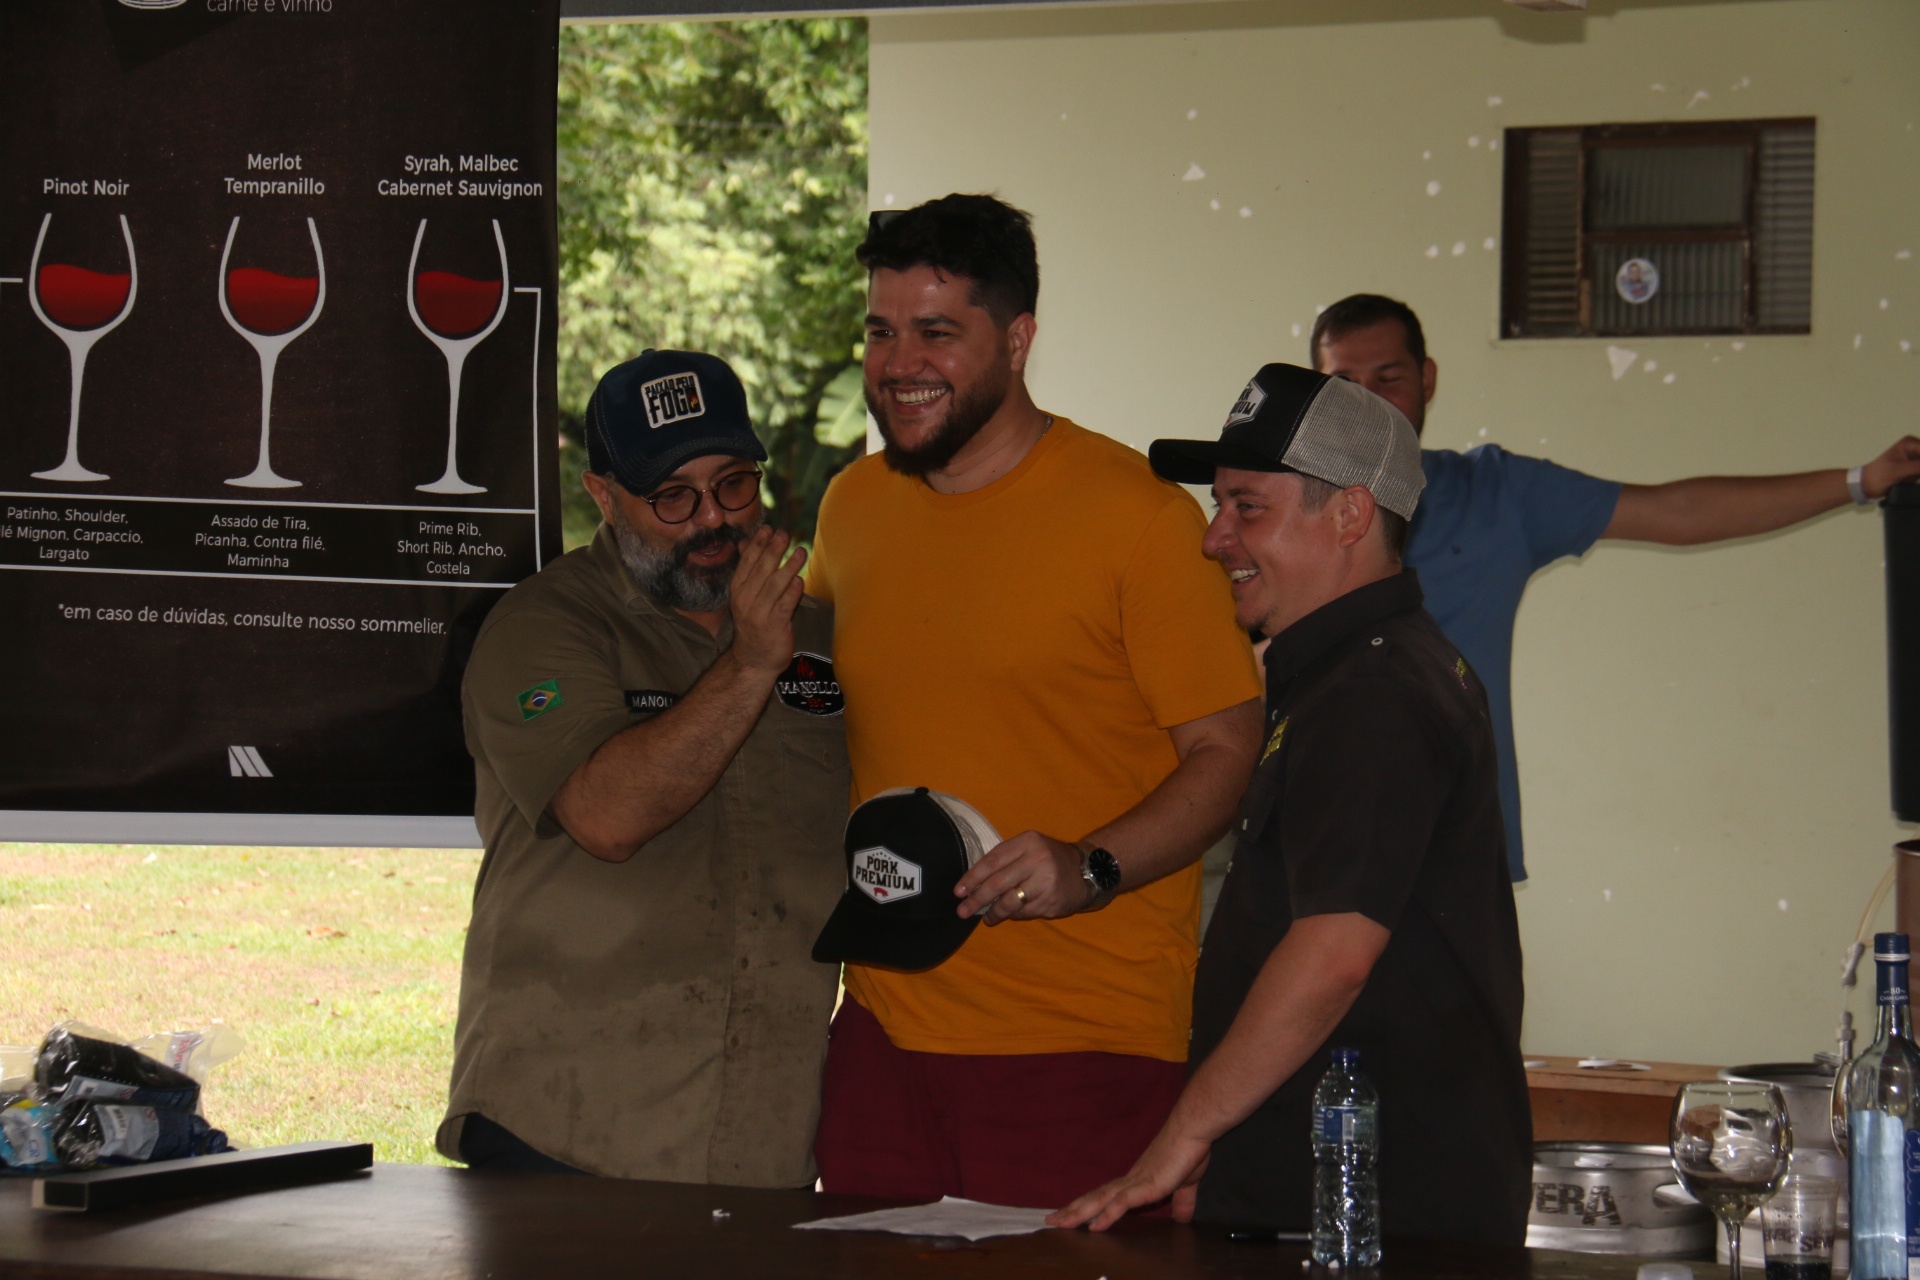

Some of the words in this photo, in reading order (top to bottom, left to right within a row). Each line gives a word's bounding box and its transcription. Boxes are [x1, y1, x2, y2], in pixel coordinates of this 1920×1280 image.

[207, 0, 258, 12] carne
[265, 0, 275, 11] e
[248, 153, 302, 170] Merlot
[405, 154, 453, 175] Syrah,
[460, 155, 518, 171] Malbec
[44, 178, 88, 194] Pinot
[94, 179, 129, 195] Noir
[224, 178, 324, 197] Tempranillo
[378, 179, 453, 195] Cabernet
[458, 179, 542, 199] Sauvignon
[8, 507, 60, 521] Patinho,
[65, 509, 128, 523] Shoulder,
[211, 515, 258, 527] Assado
[262, 516, 279, 528] de
[284, 517, 309, 530] Tira,
[0, 525, 13, 538] lé
[17, 527, 69, 541] Mignon,
[74, 529, 143, 543] Carpaccio,
[420, 522, 453, 534] Prime
[458, 523, 481, 536] Rib,
[196, 533, 249, 547] Picanha,
[254, 535, 297, 548] Contra
[303, 536, 325, 549] filé,
[398, 540, 429, 553] Short
[434, 542, 455, 555] Rib,
[459, 543, 506, 557] Ancho,
[39, 546, 90, 562] Largato
[227, 553, 290, 568] Maminha
[427, 561, 470, 574] Costela
[97, 608, 132, 621] caso
[138, 606, 158, 622] de
[163, 607, 227, 626] dúvidas,
[234, 612, 302, 628] consulte
[309, 617, 355, 630] nosso
[361, 618, 446, 634] sommelier.
[867, 856, 898, 875] PORK
[855, 866, 915, 891] PREMIUM
[1532, 1182, 1622, 1226] ERA
